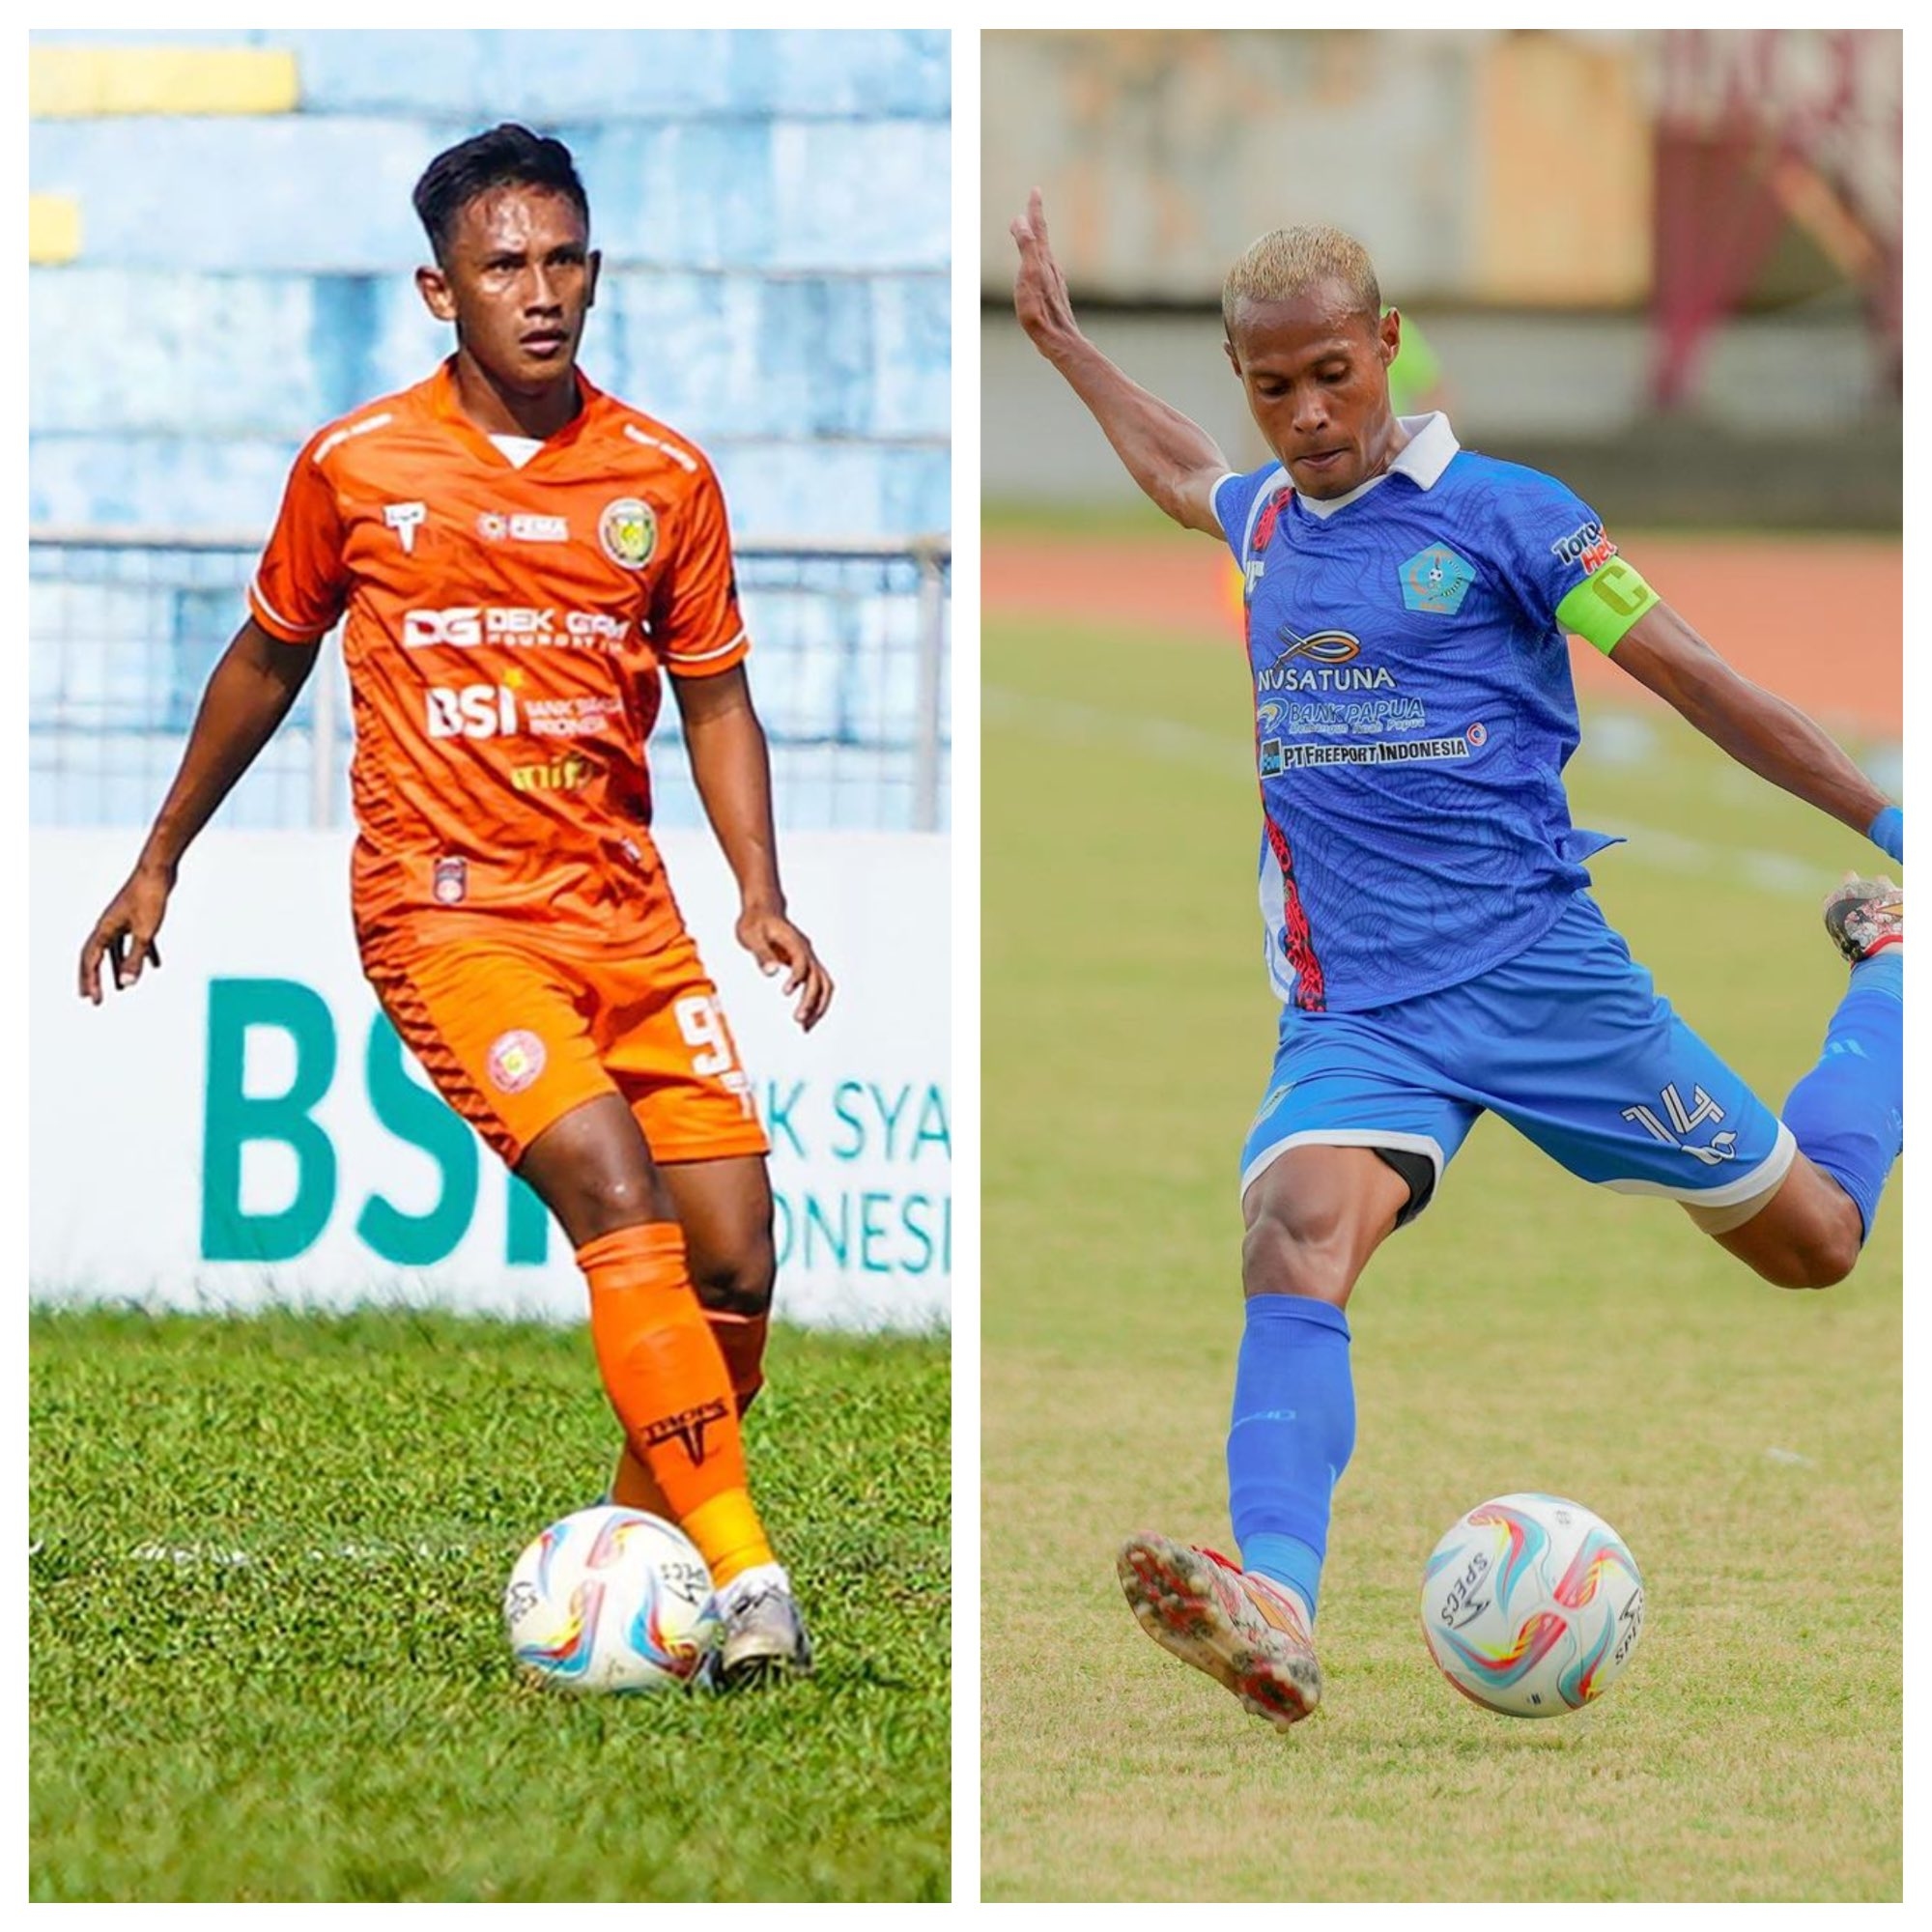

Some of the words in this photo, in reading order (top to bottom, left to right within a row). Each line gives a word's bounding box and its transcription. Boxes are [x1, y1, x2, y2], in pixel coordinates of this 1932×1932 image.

[1592, 565, 1648, 616] C
[404, 607, 481, 647] DG
[486, 609, 555, 633] DEK
[1259, 667, 1396, 692] NUSATUNA
[426, 682, 518, 739] BSI
[1345, 697, 1425, 723] PAPUA
[1379, 740, 1467, 761] INDONESIA
